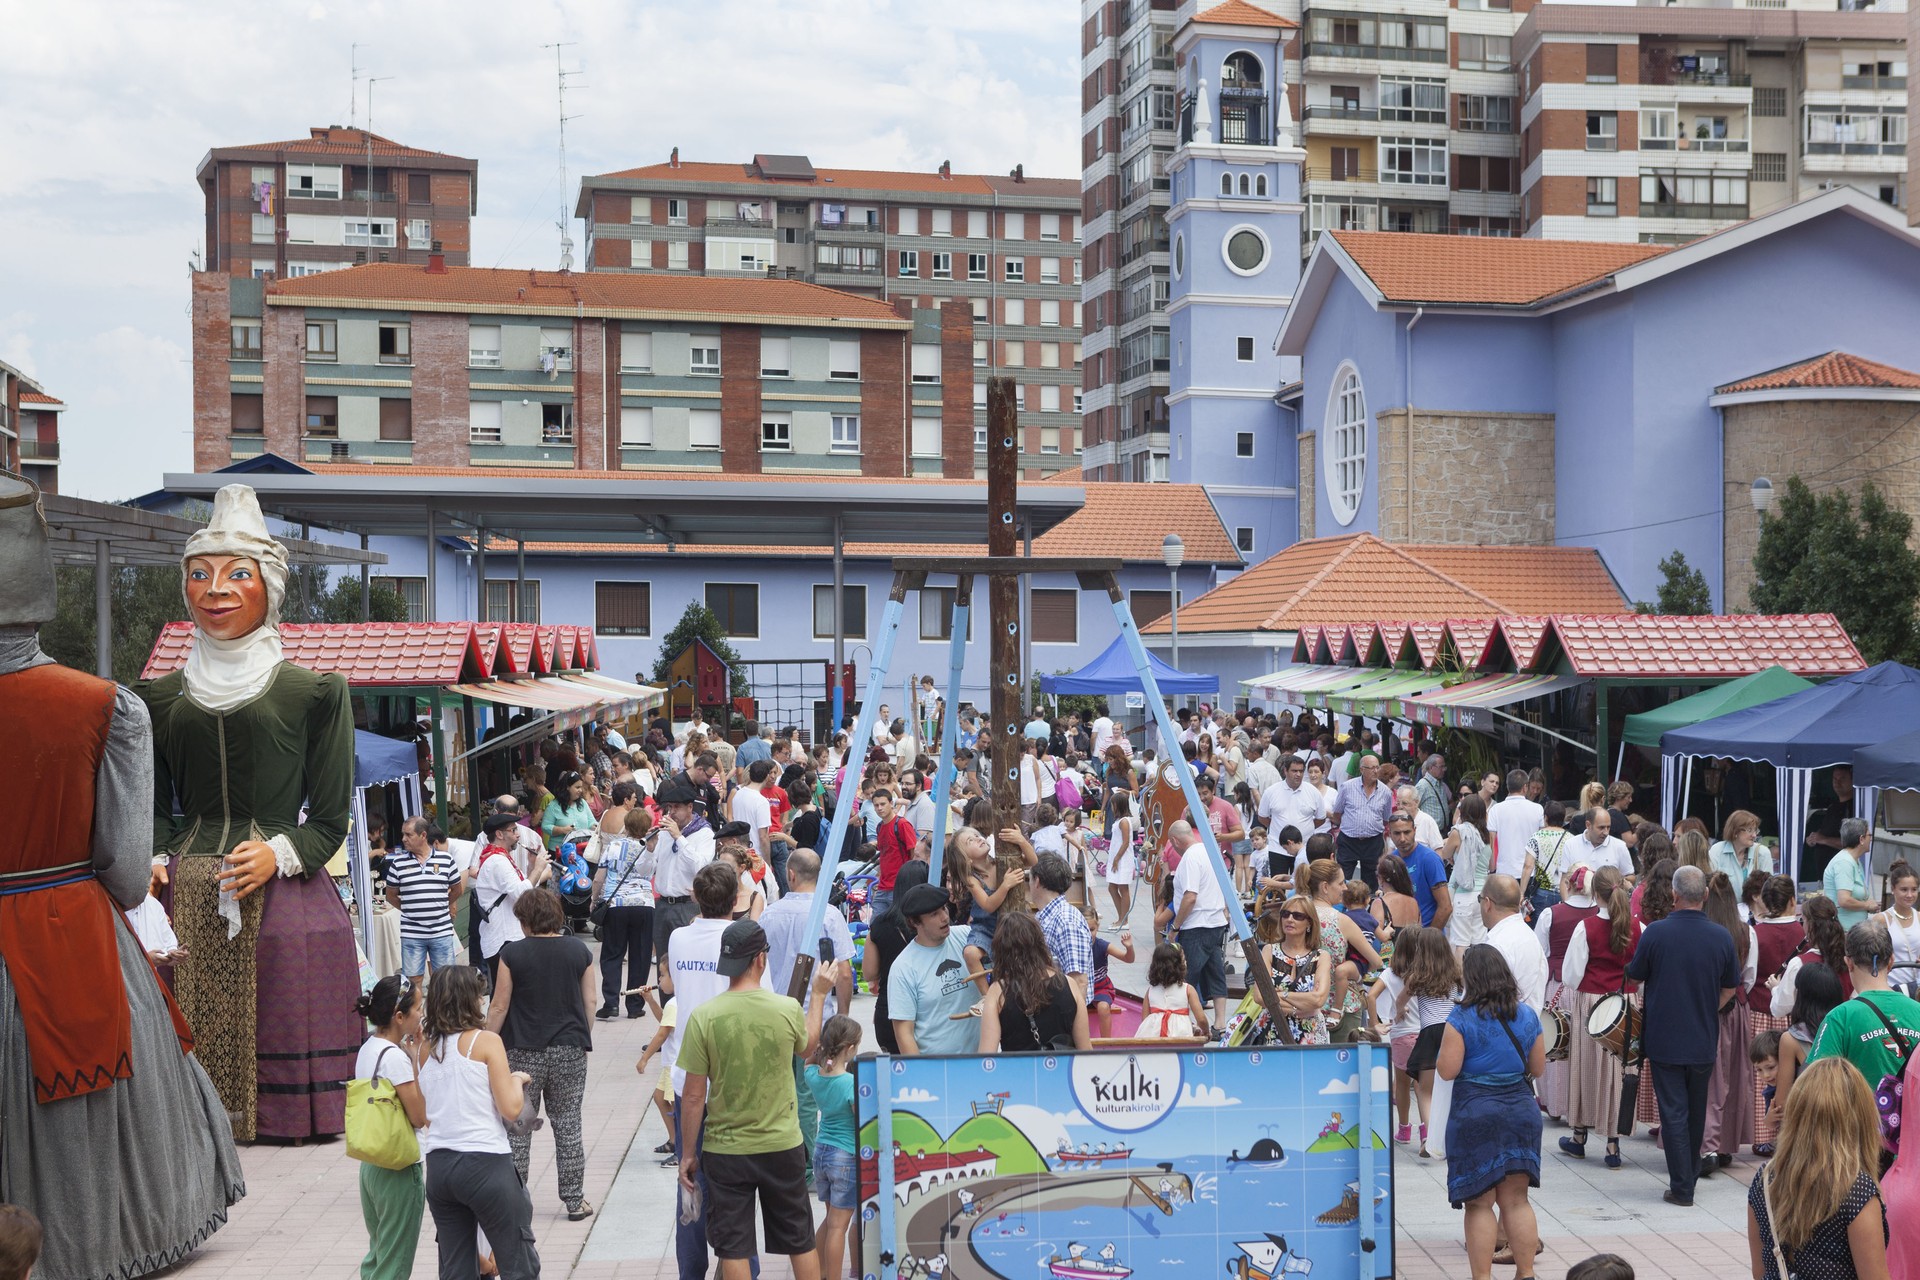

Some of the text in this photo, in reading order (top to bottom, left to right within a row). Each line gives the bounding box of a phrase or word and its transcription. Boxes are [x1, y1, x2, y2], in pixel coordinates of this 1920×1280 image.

[1860, 1027, 1892, 1042] EUSKA
[1197, 1055, 1205, 1064] D
[1252, 1054, 1260, 1063] E
[1339, 1051, 1347, 1061] F
[895, 1062, 903, 1072] A
[985, 1060, 993, 1069] B
[1046, 1058, 1054, 1067] C
[1091, 1062, 1160, 1102] kulki
